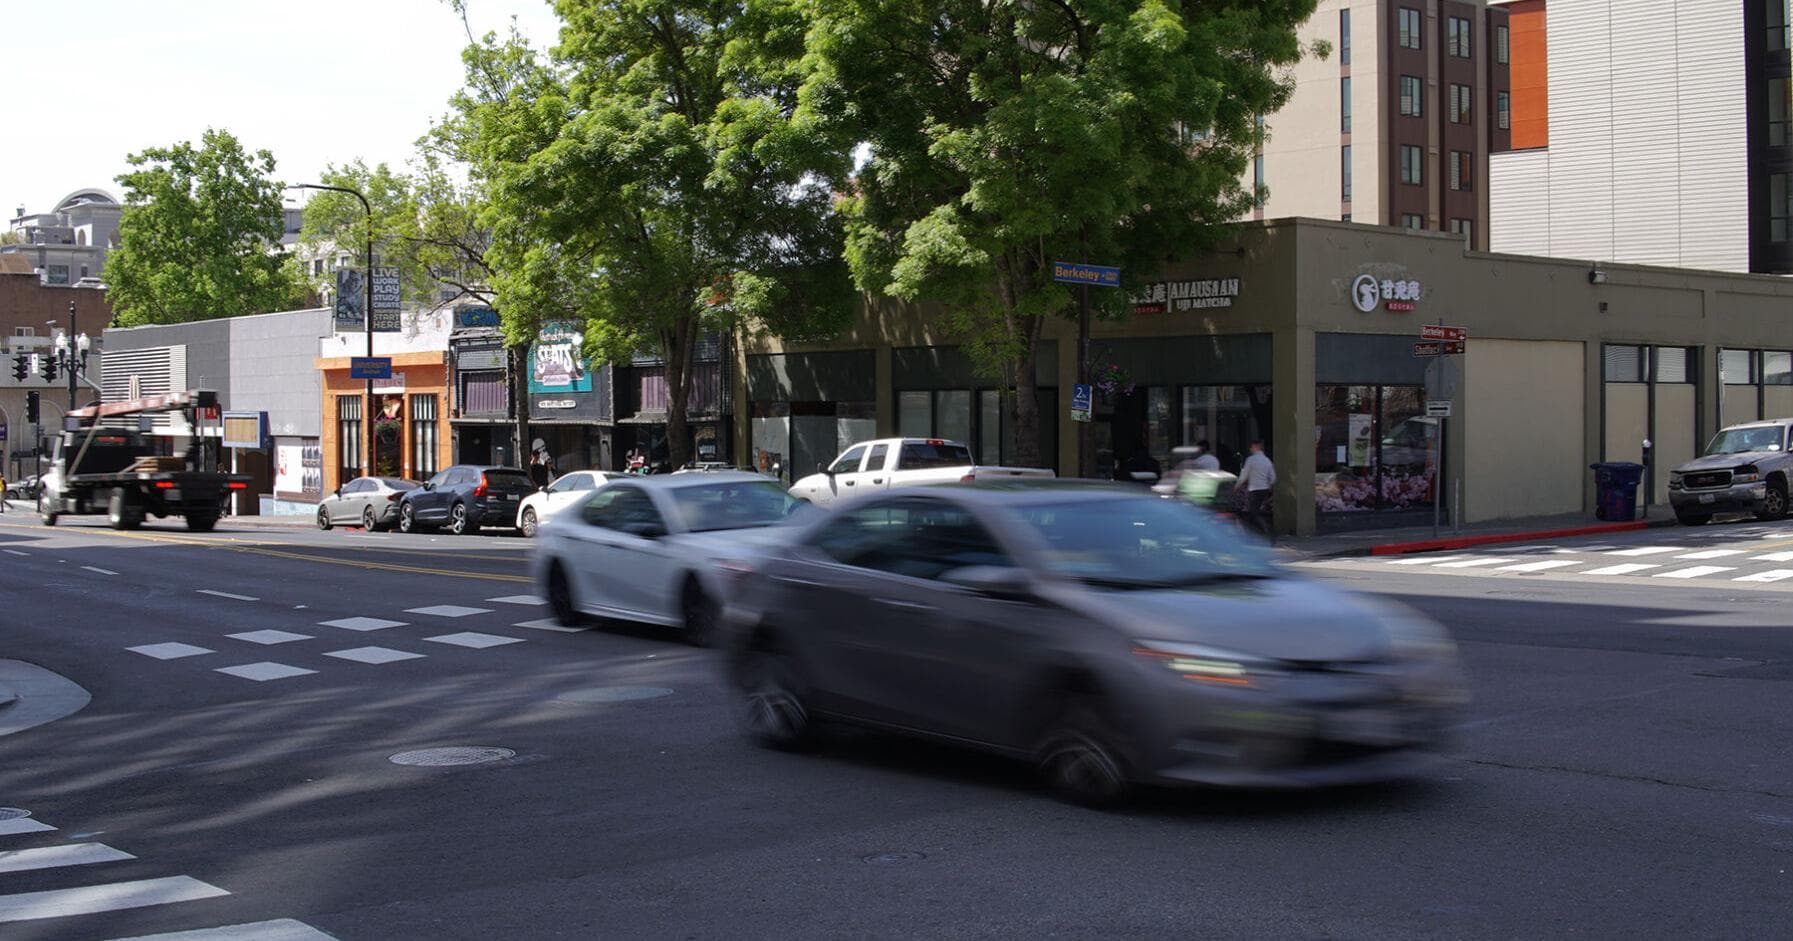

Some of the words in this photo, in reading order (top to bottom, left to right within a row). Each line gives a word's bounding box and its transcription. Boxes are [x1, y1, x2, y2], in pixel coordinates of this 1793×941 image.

[373, 267, 400, 277] LIVE
[1056, 266, 1099, 281] Berkeley
[373, 285, 400, 295] PLAY
[1170, 279, 1239, 299] AMAUSAAN
[1193, 297, 1231, 308] MATCHA
[1076, 386, 1083, 398] 2
